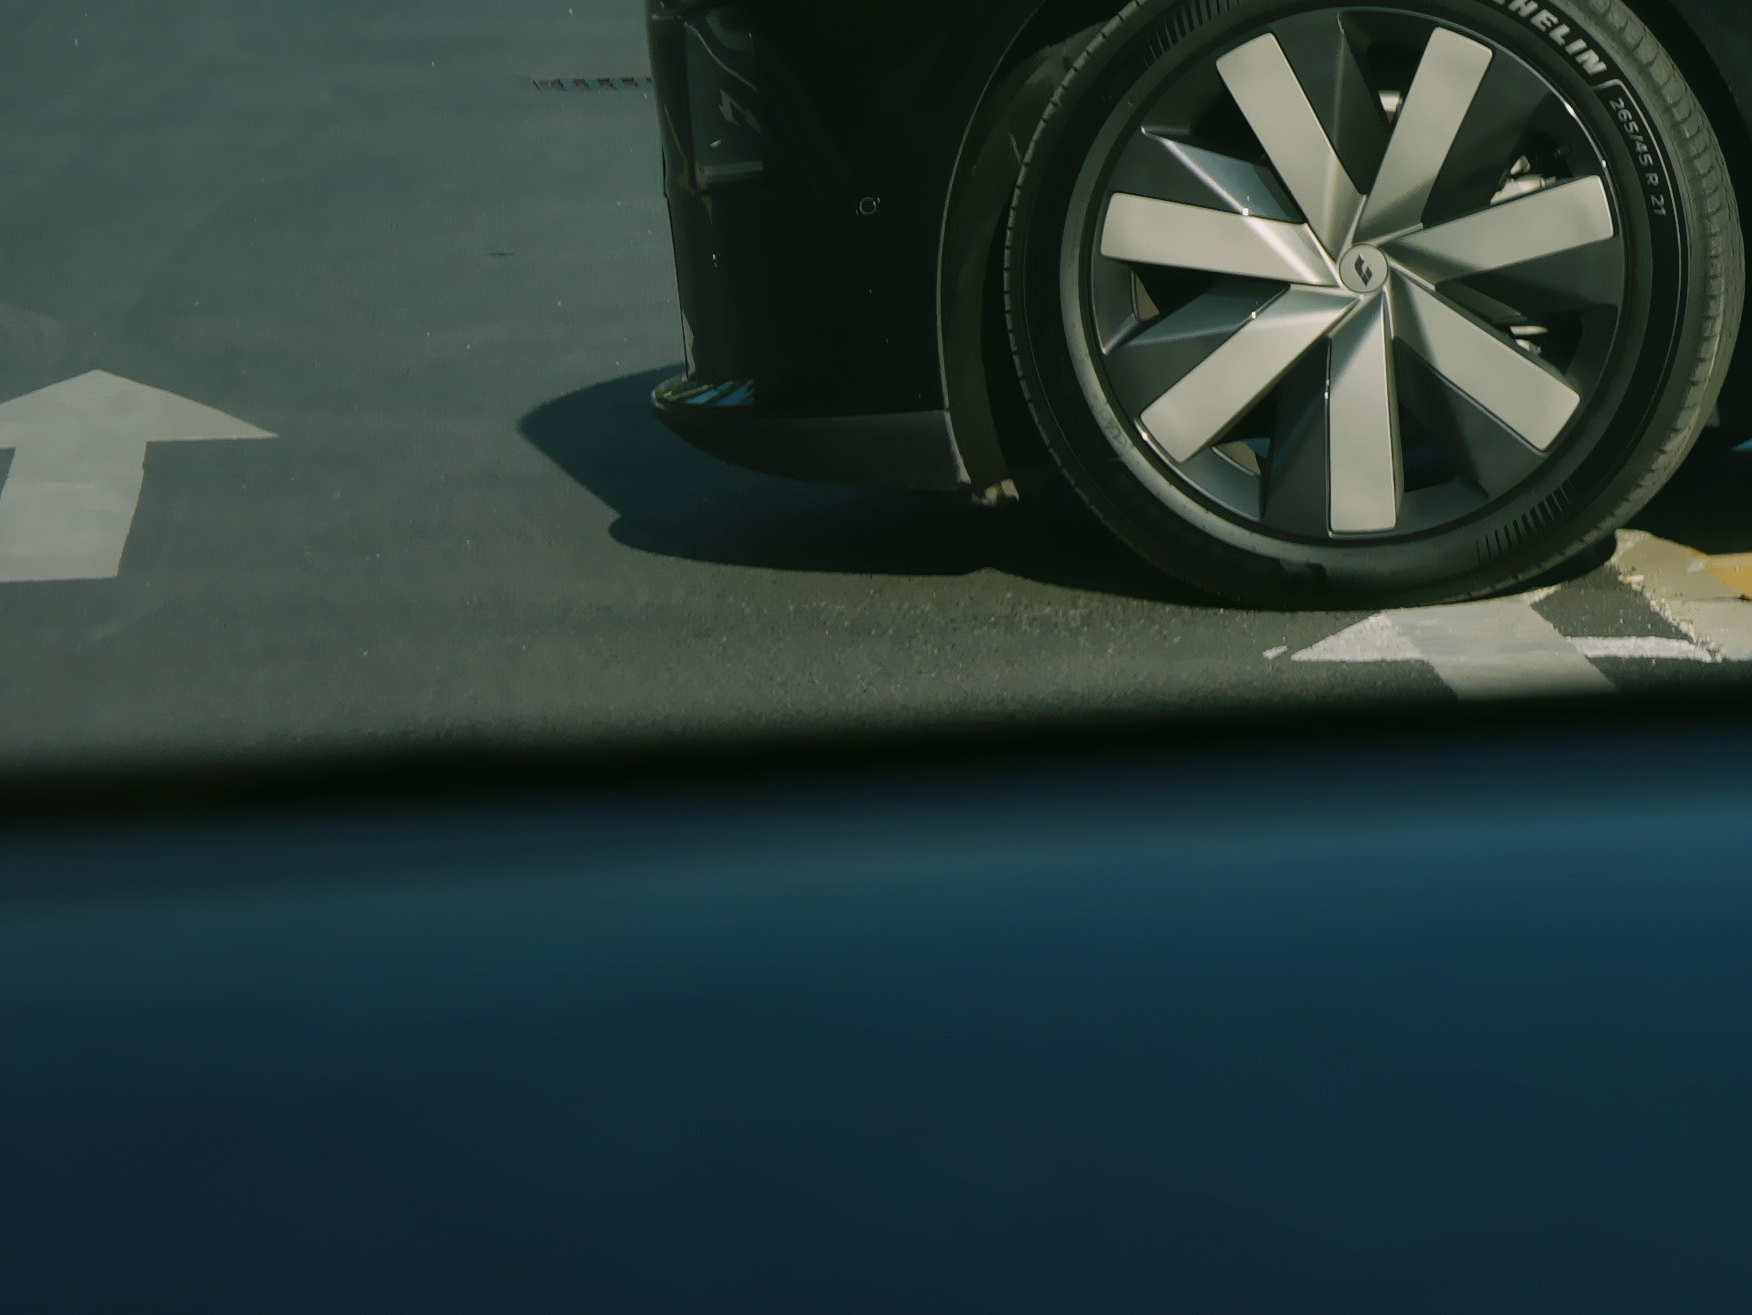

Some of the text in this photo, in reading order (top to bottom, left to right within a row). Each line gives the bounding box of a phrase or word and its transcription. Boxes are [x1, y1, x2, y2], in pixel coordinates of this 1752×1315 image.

[1610, 97, 1667, 217] 265/45 R 21
